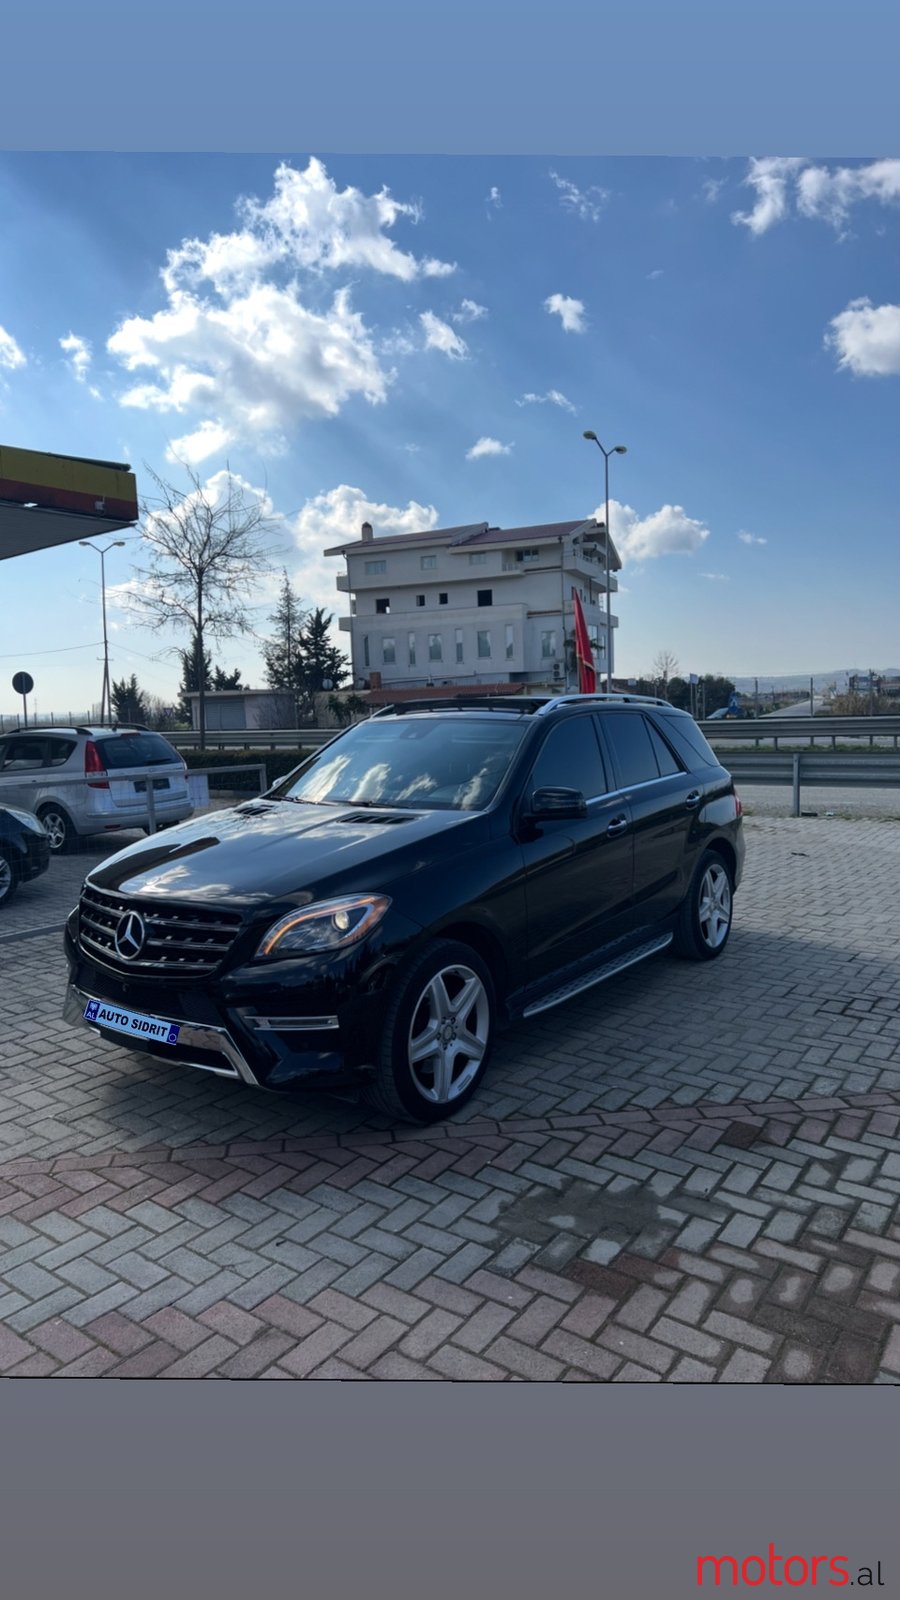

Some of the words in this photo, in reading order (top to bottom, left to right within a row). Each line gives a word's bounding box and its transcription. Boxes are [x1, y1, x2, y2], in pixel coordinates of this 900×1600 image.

[86, 1011, 96, 1020] AL
[98, 1009, 129, 1026] AUTO
[131, 1018, 168, 1037] SIDRIT
